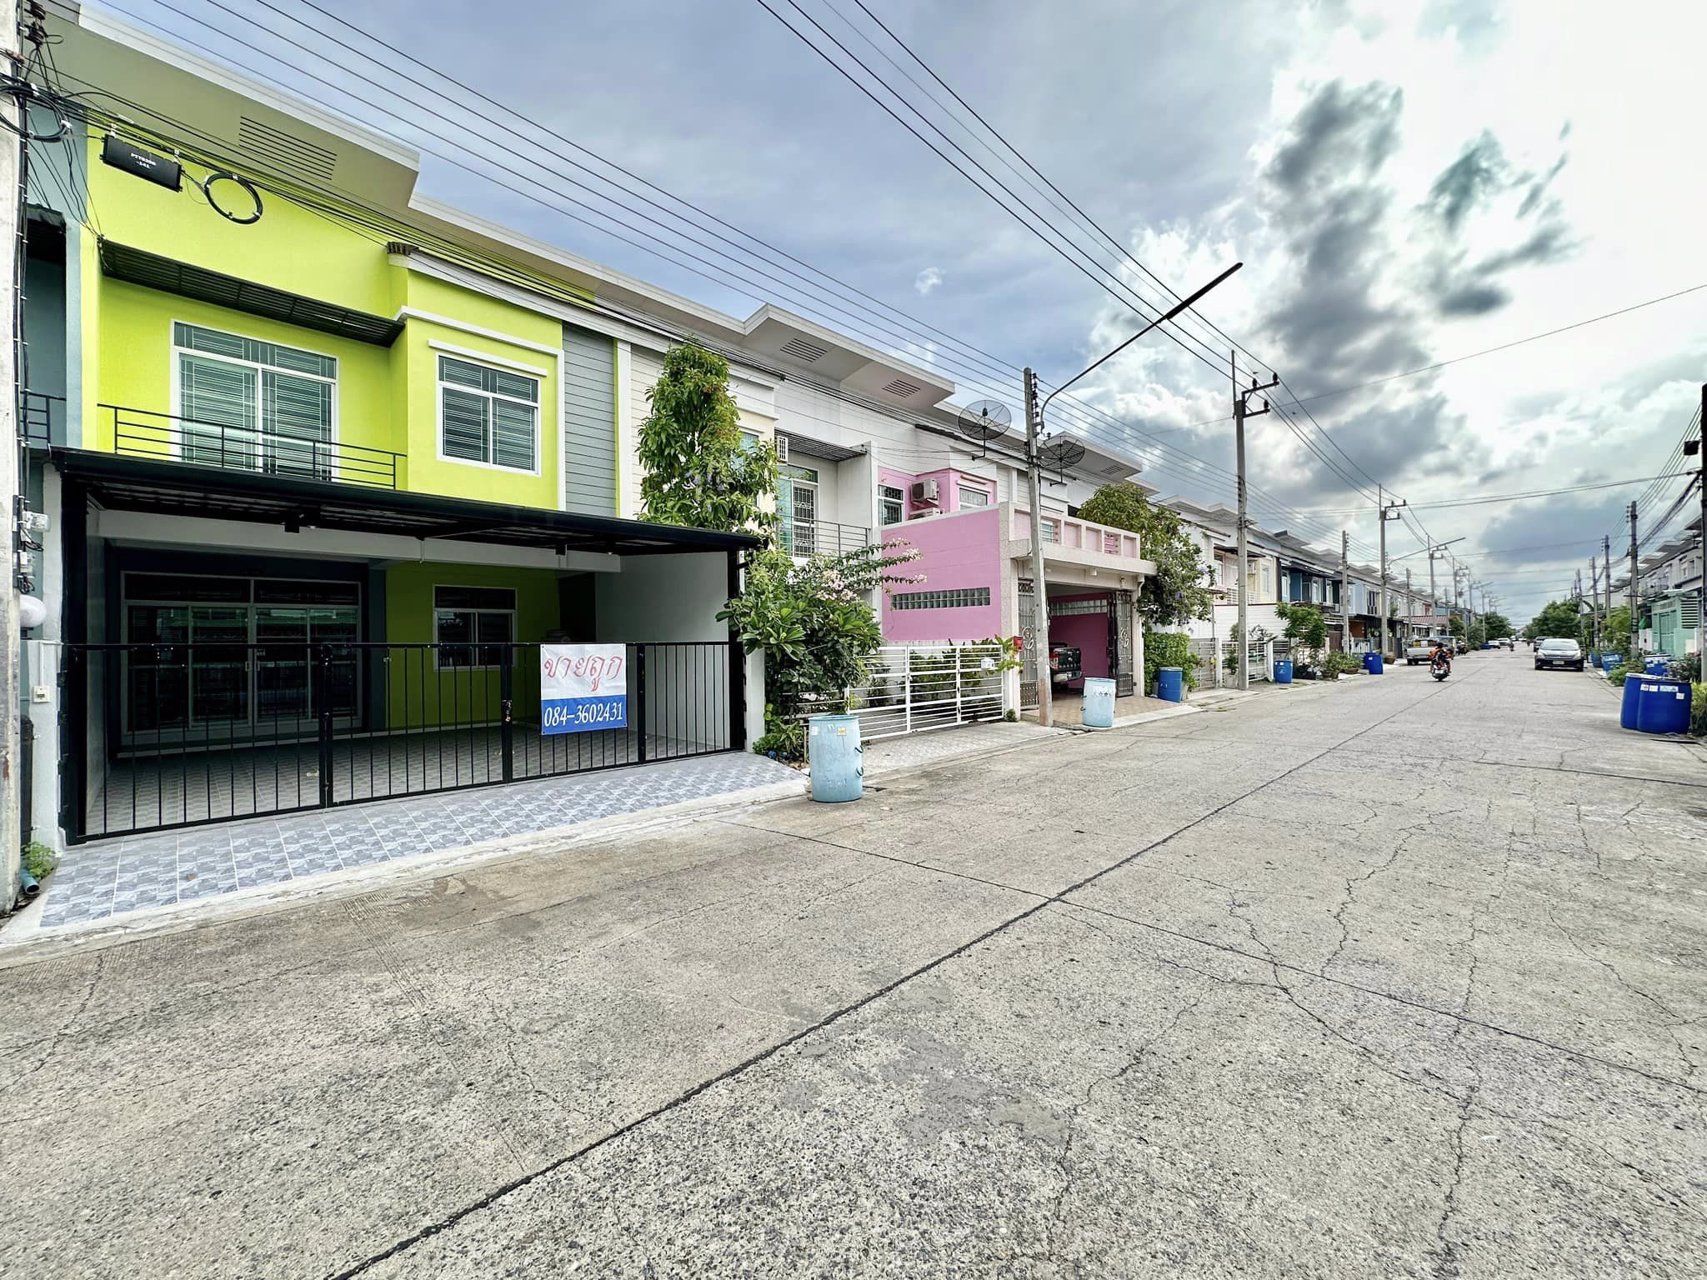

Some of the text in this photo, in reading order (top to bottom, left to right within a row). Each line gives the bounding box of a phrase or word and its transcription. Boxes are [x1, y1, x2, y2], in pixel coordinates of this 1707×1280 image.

[544, 654, 622, 692] ขายถูก
[544, 702, 623, 727] 084-3602431
